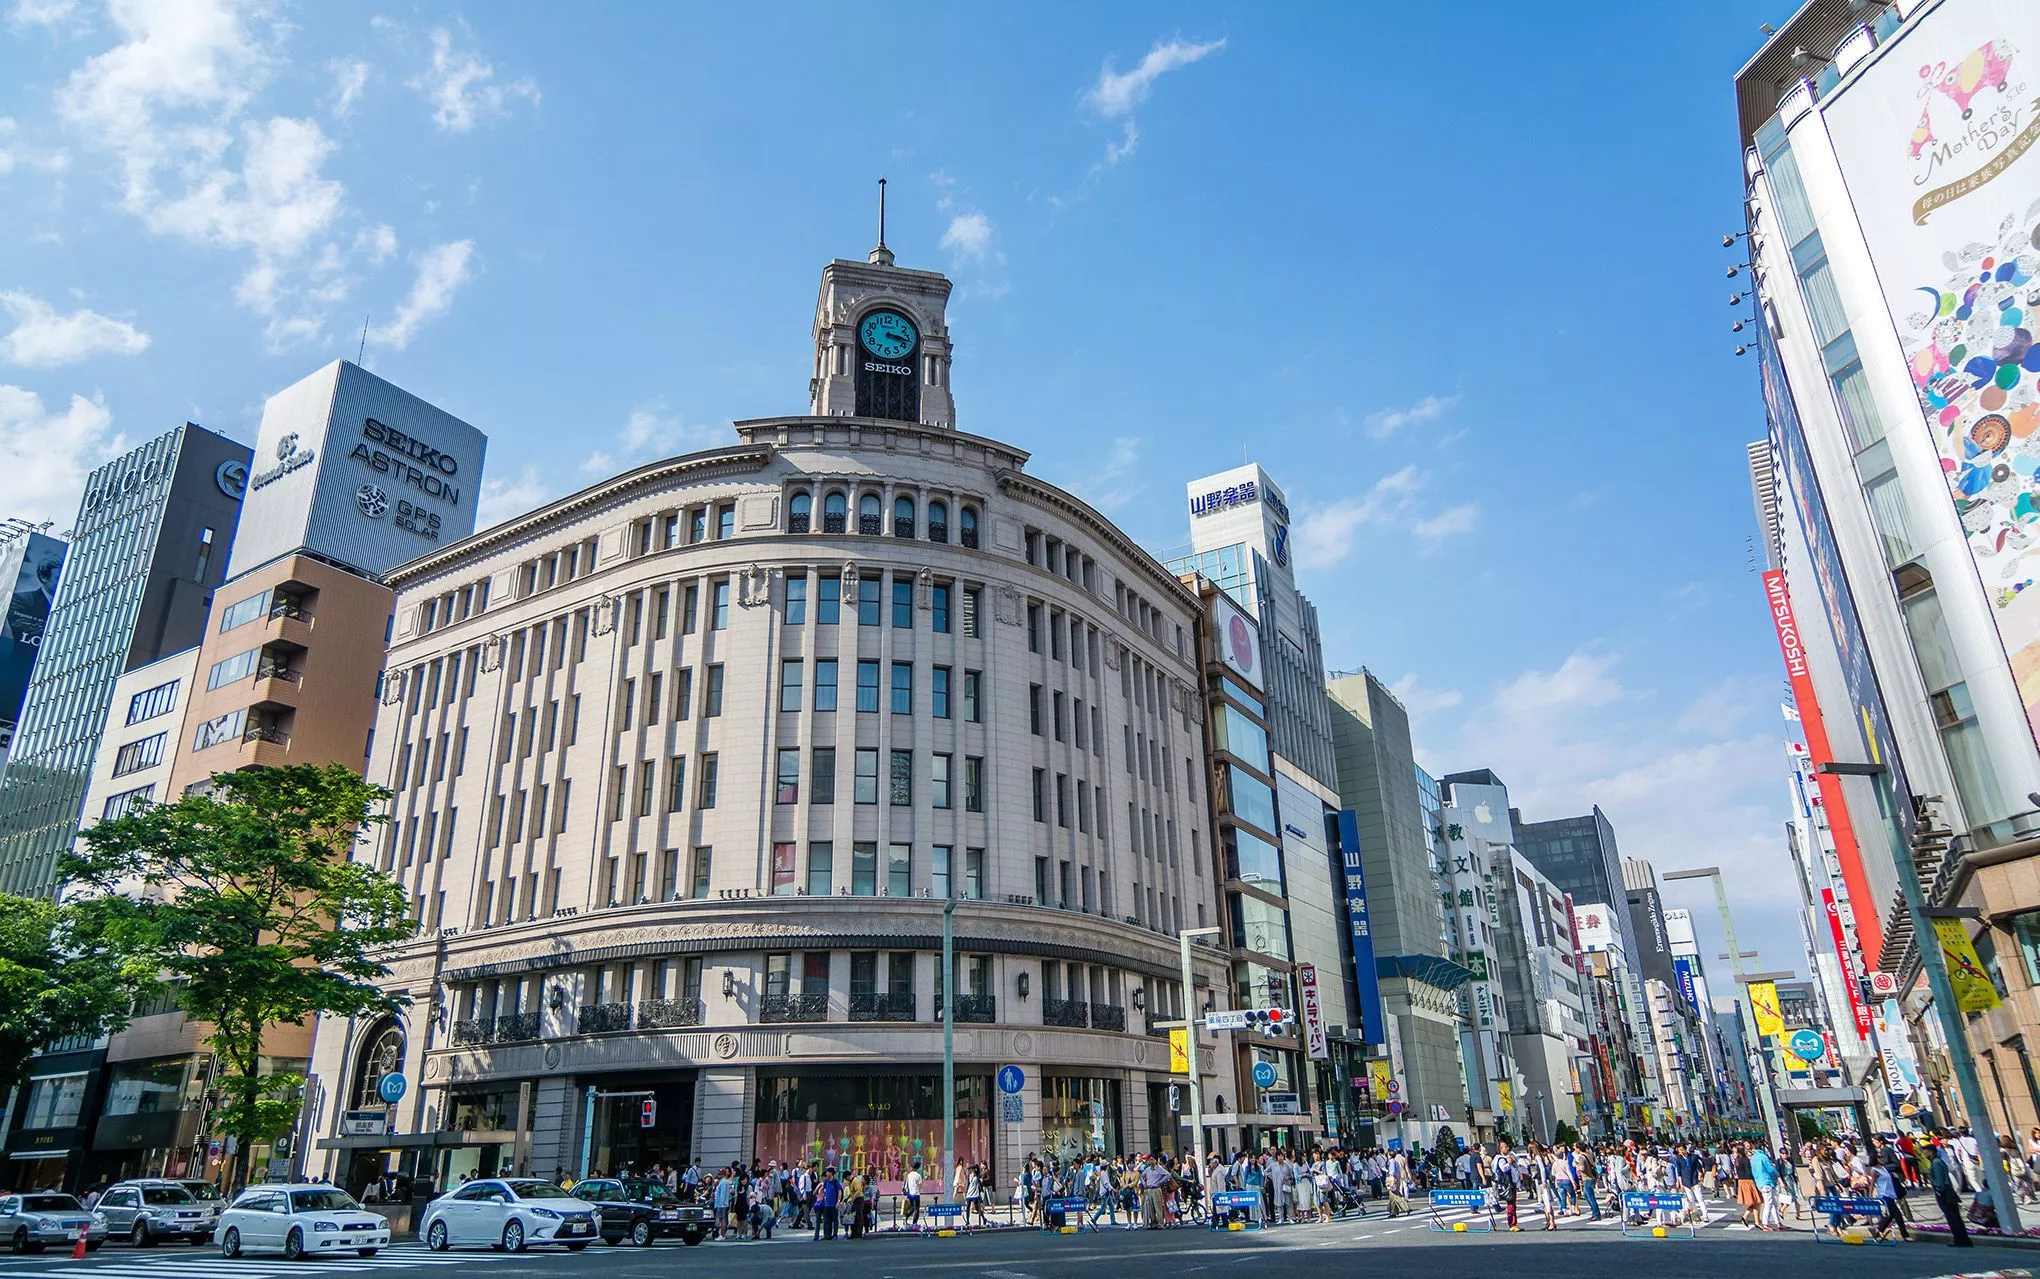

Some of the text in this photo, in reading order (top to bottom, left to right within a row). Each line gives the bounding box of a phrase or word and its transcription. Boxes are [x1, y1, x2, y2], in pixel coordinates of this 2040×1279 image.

[1914, 105, 2012, 185] Mother's
[1977, 108, 2022, 151] Day
[869, 322, 876, 330] 10
[884, 316, 892, 324] 12
[876, 343, 883, 352] 7
[884, 347, 891, 355] 6
[893, 346, 899, 354] 5
[900, 341, 906, 349] 4
[864, 362, 912, 376] SEIKO
[363, 417, 458, 477] SEIKO
[349, 443, 459, 505] ASTRON
[1190, 481, 1256, 515] 山野楽器
[395, 515, 439, 542] SOLAR
[398, 499, 442, 530] GPS
[1766, 576, 1806, 678] MITSUKOSHI
[1448, 823, 1474, 907] 教文館
[1344, 852, 1368, 937] 山野楽器
[1468, 956, 1485, 977] 本
[1682, 970, 1695, 1002] MIZUHO
[1305, 989, 1321, 1054] キムラヤのパン
